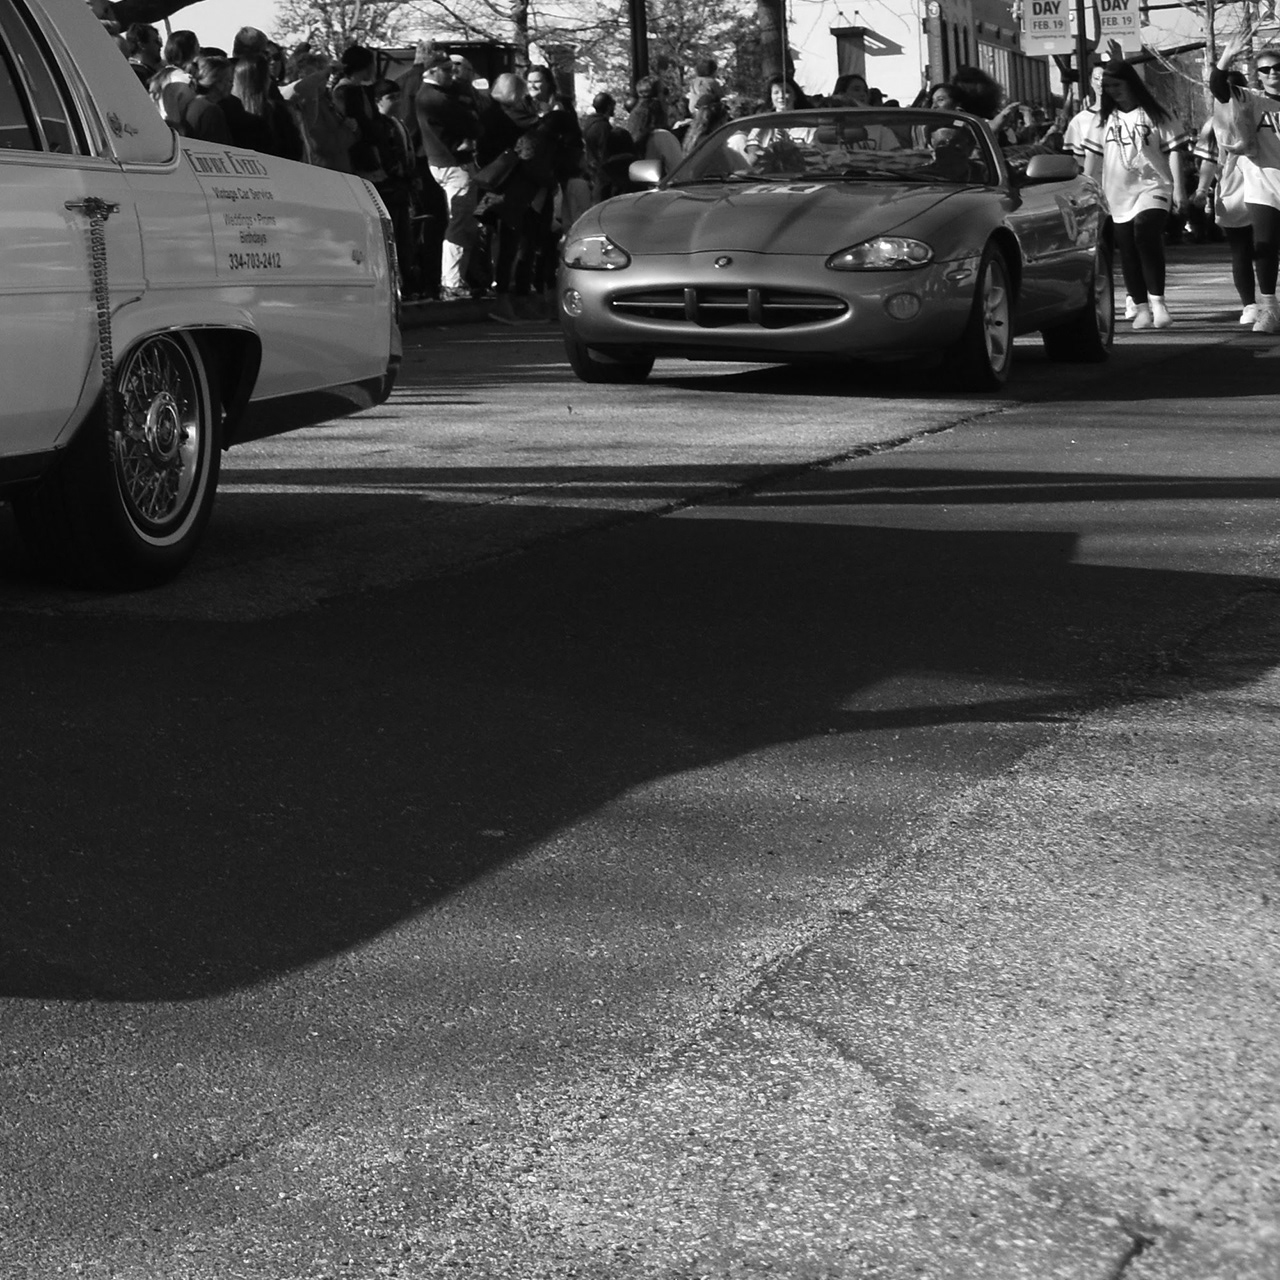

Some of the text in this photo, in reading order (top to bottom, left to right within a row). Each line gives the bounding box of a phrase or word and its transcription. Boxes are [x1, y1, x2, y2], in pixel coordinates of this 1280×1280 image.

[1032, 1, 1061, 16] DAY
[1033, 19, 1064, 30] FEB. 19
[1102, 16, 1133, 26] FEB. 19
[212, 187, 274, 202] Vintage Car Service
[223, 213, 276, 228] Weddings Proms
[240, 231, 267, 246] Birthdays
[229, 252, 281, 270] 334-703-2412
